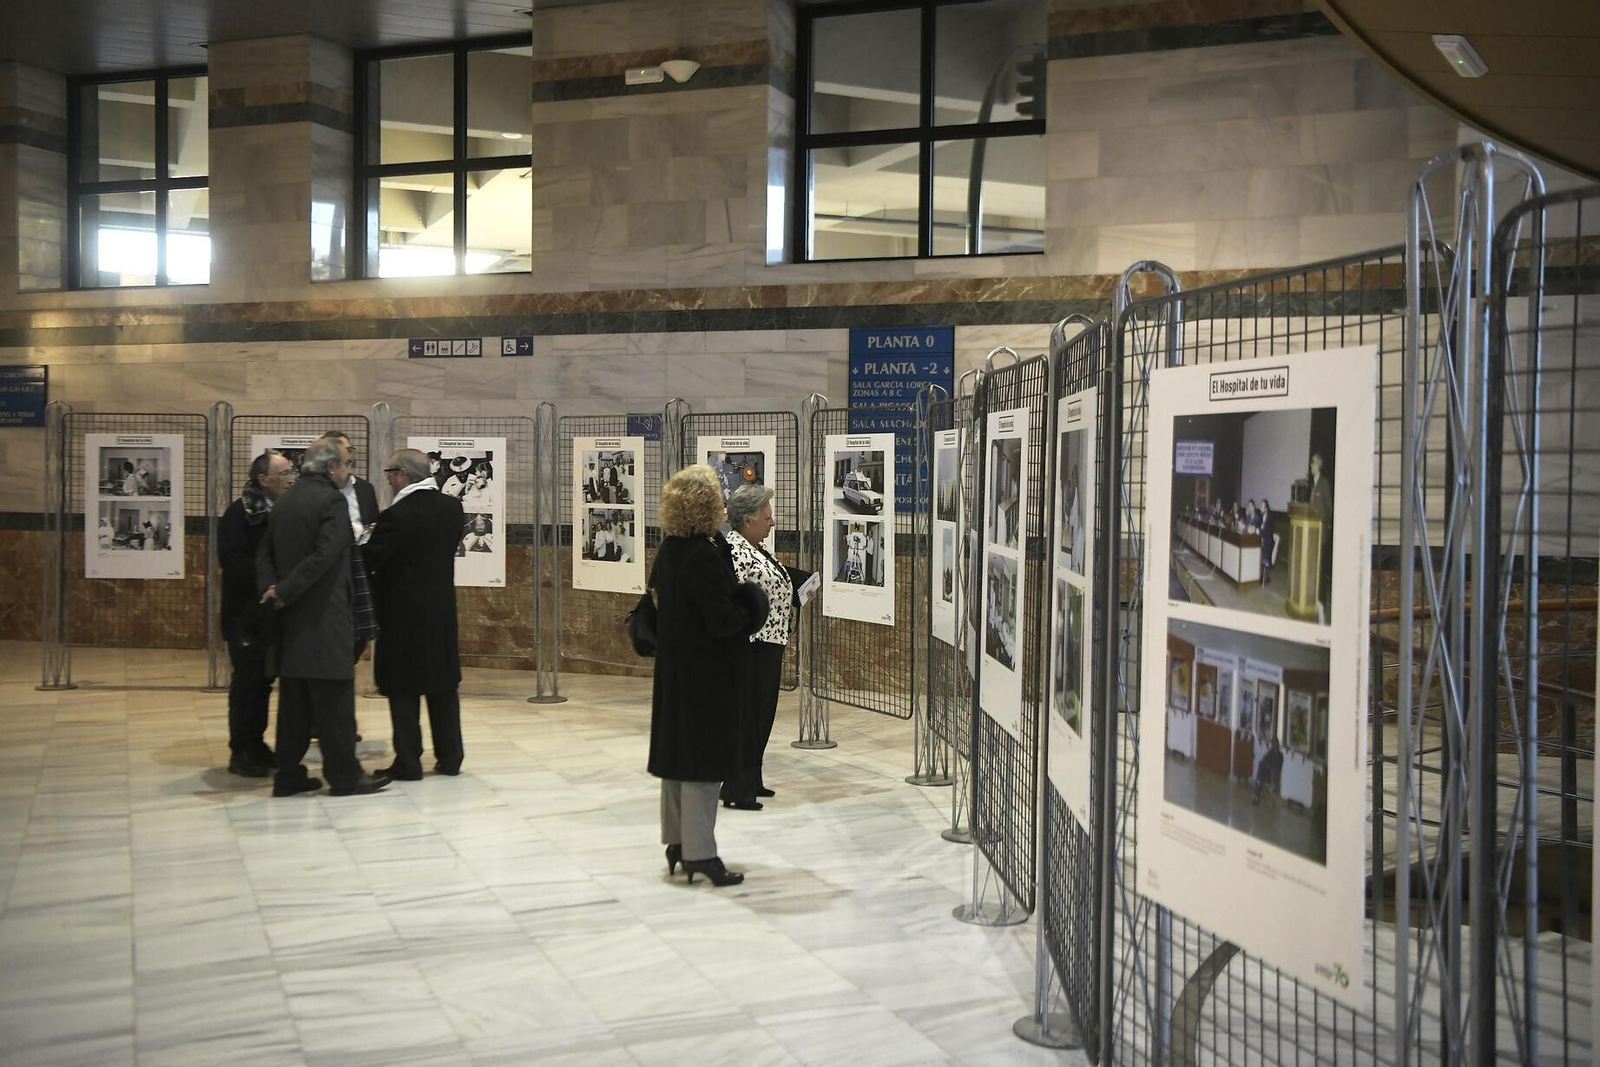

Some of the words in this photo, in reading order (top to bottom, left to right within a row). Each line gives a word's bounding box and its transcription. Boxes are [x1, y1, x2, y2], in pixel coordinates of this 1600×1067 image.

[867, 335, 920, 348] PLANTA
[926, 335, 934, 348] 0
[864, 362, 917, 375] PLANTA
[922, 362, 937, 375] -2
[852, 381, 872, 389] SALA
[874, 381, 904, 389] GARCIA
[1212, 380, 1218, 394] El
[1220, 378, 1248, 395] Hospital
[1250, 377, 1258, 391] de
[1260, 377, 1268, 390] tu
[1269, 375, 1285, 389] vida
[852, 389, 879, 397] ZONAS
[881, 389, 888, 397] A
[889, 389, 895, 397] B
[896, 389, 903, 397] C
[852, 420, 875, 428] SALA
